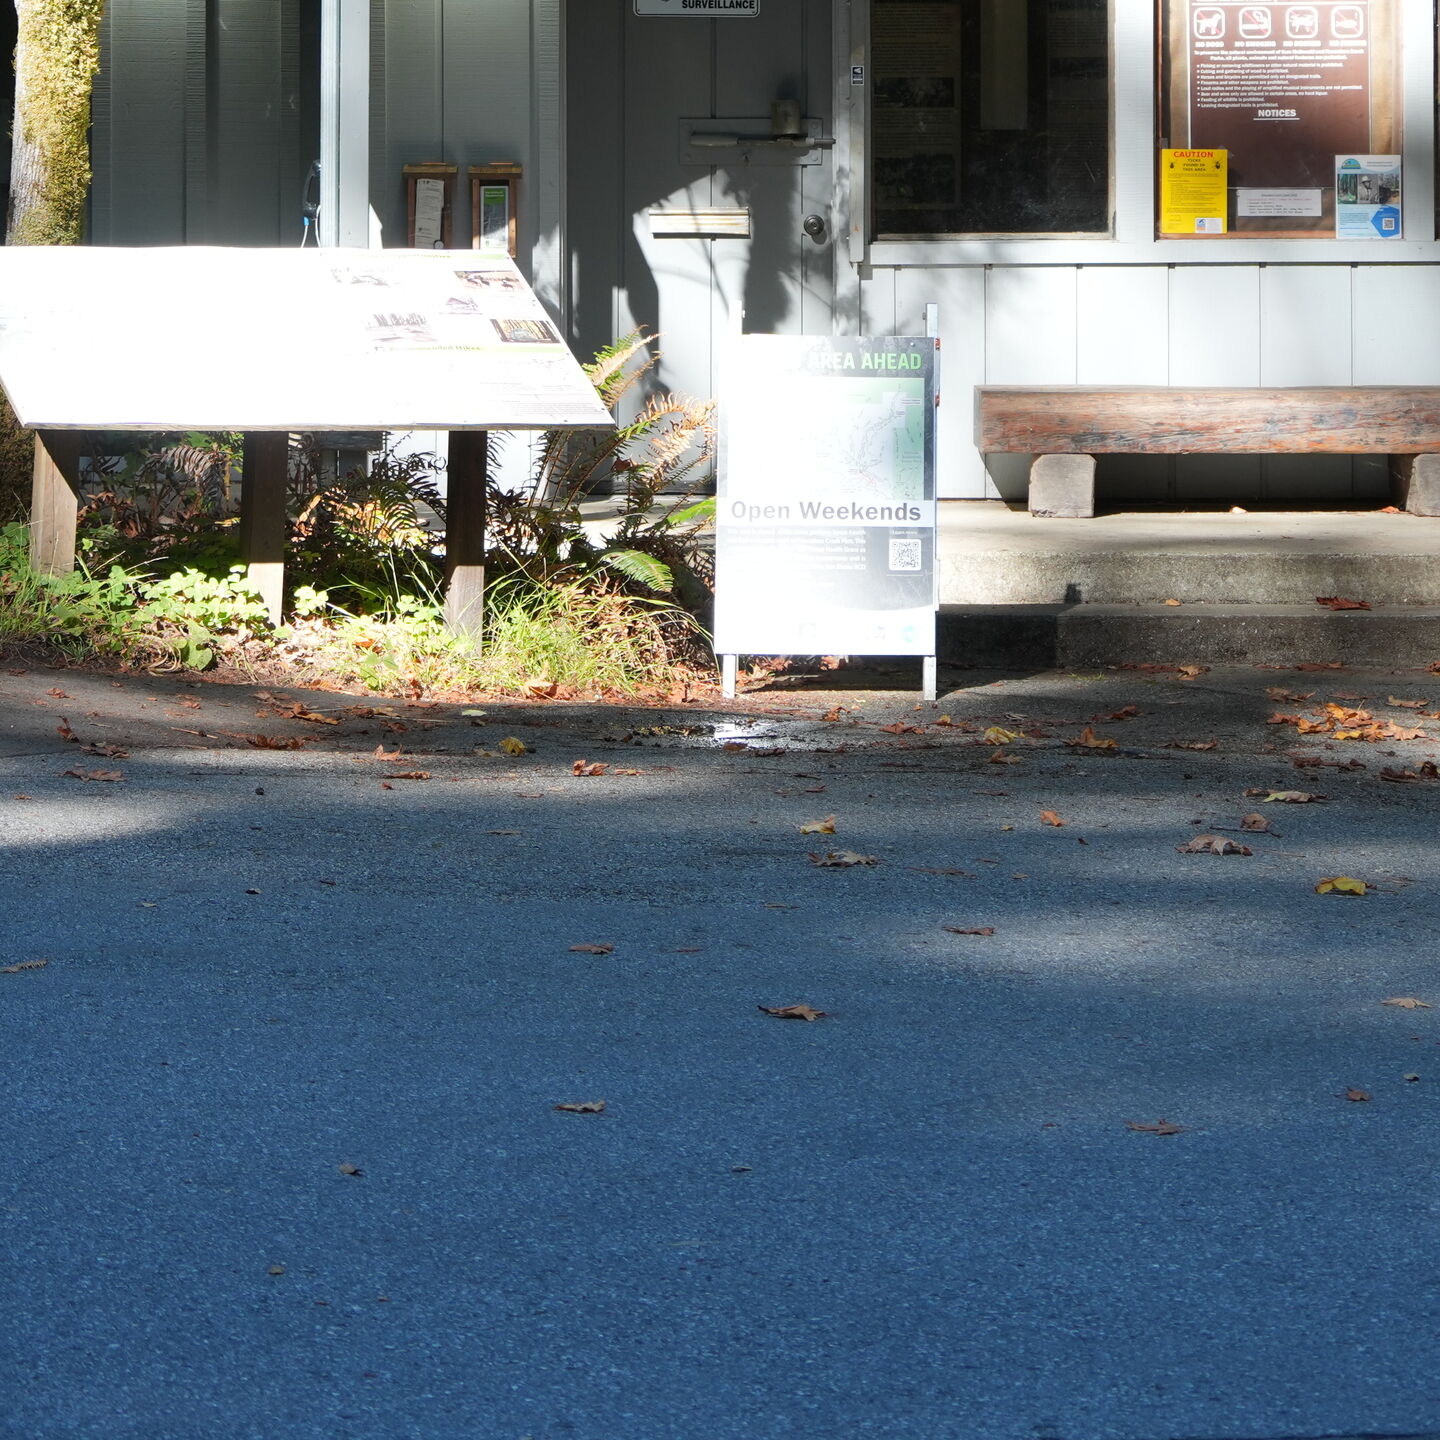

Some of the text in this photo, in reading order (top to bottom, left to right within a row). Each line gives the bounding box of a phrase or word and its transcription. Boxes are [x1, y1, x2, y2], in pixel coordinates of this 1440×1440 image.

[682, 0, 755, 9] SURVEILLANCE
[1258, 109, 1296, 117] NOTICES
[808, 353, 922, 370] AREA AHEAD
[731, 500, 921, 522] Open Weekends
